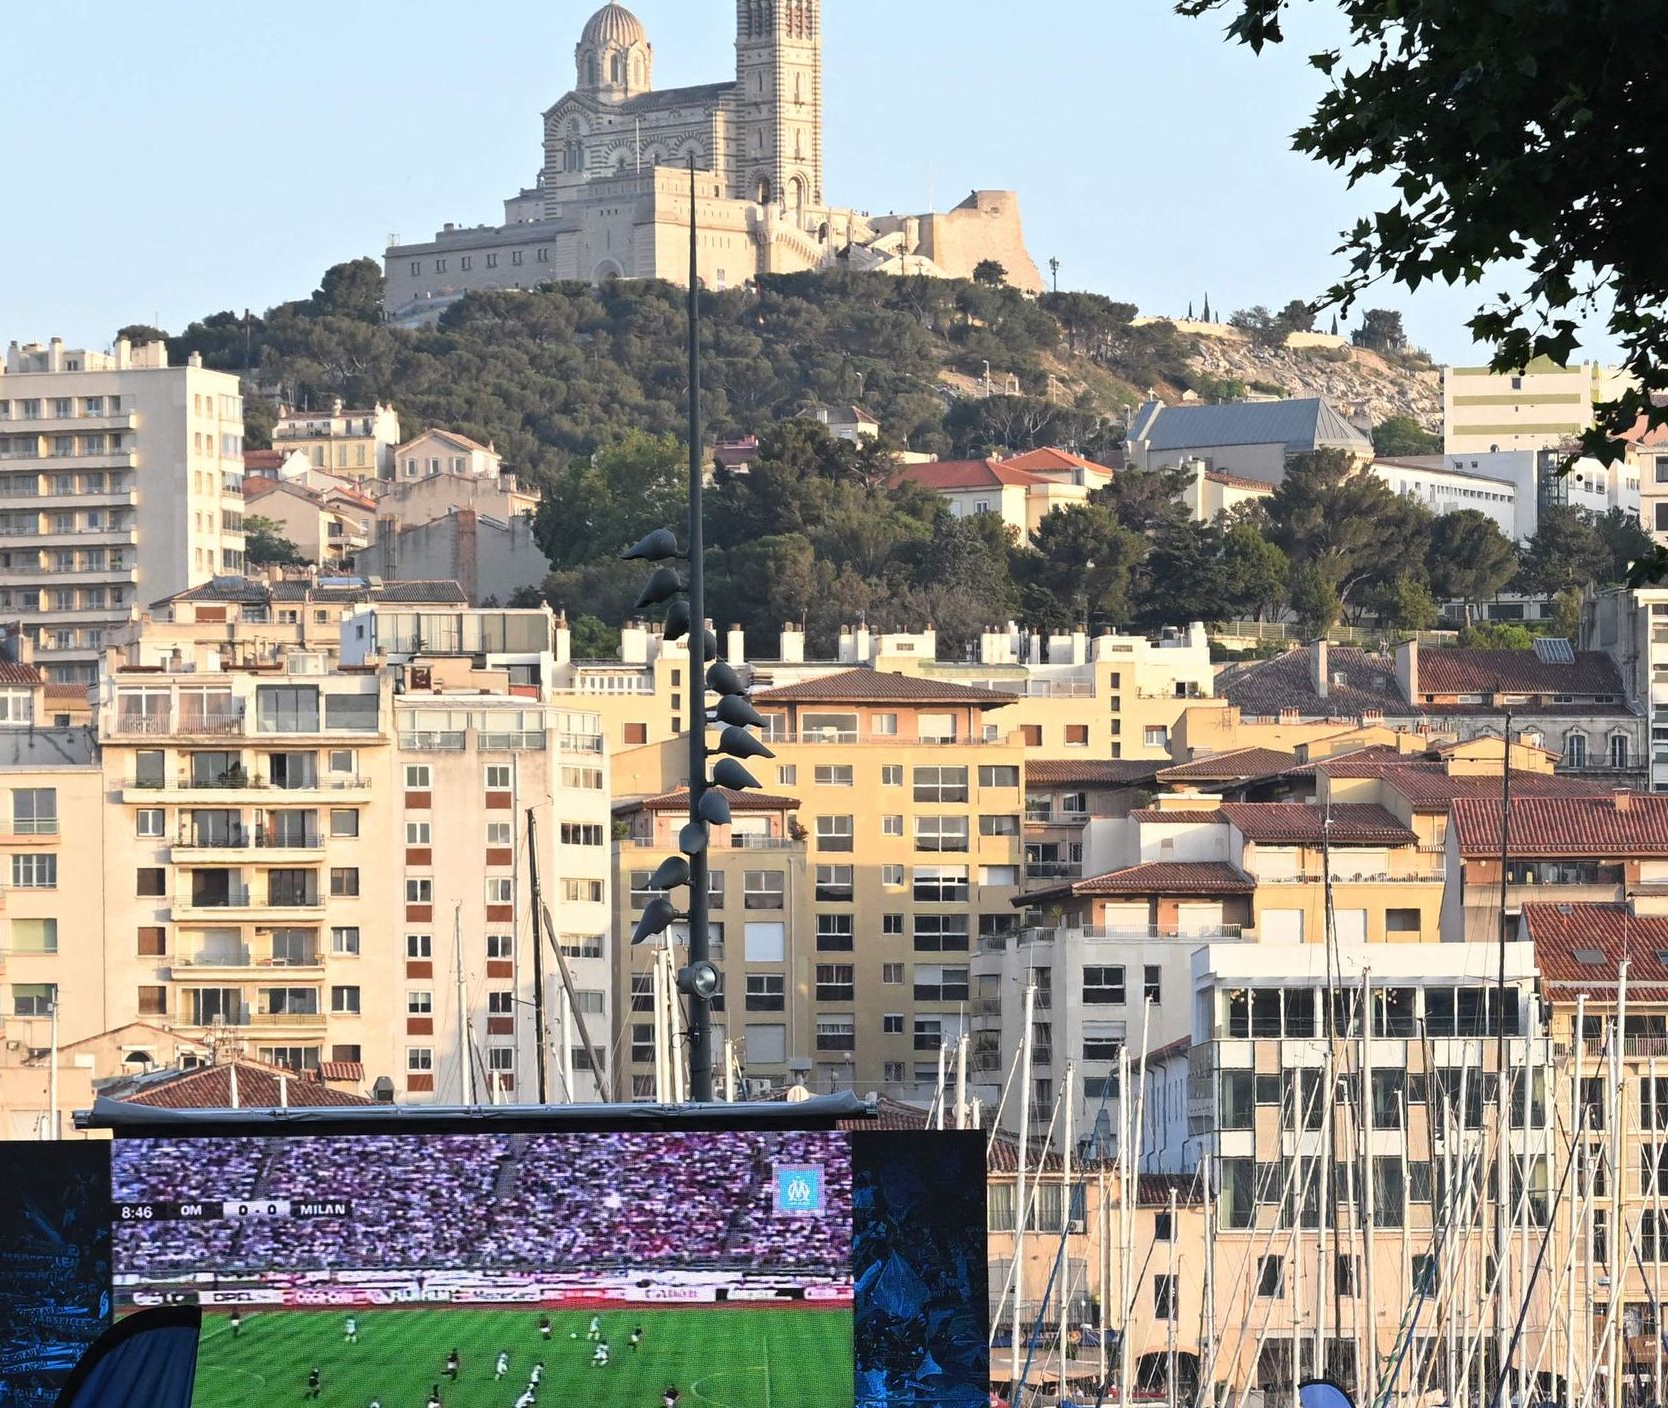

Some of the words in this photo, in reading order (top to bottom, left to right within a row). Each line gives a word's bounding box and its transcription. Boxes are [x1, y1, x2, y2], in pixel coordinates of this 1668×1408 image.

[121, 1206, 153, 1219] 8:46
[180, 1204, 202, 1216] OM
[238, 1204, 249, 1216] 0
[267, 1203, 278, 1215] 0
[299, 1203, 347, 1216] MILAN
